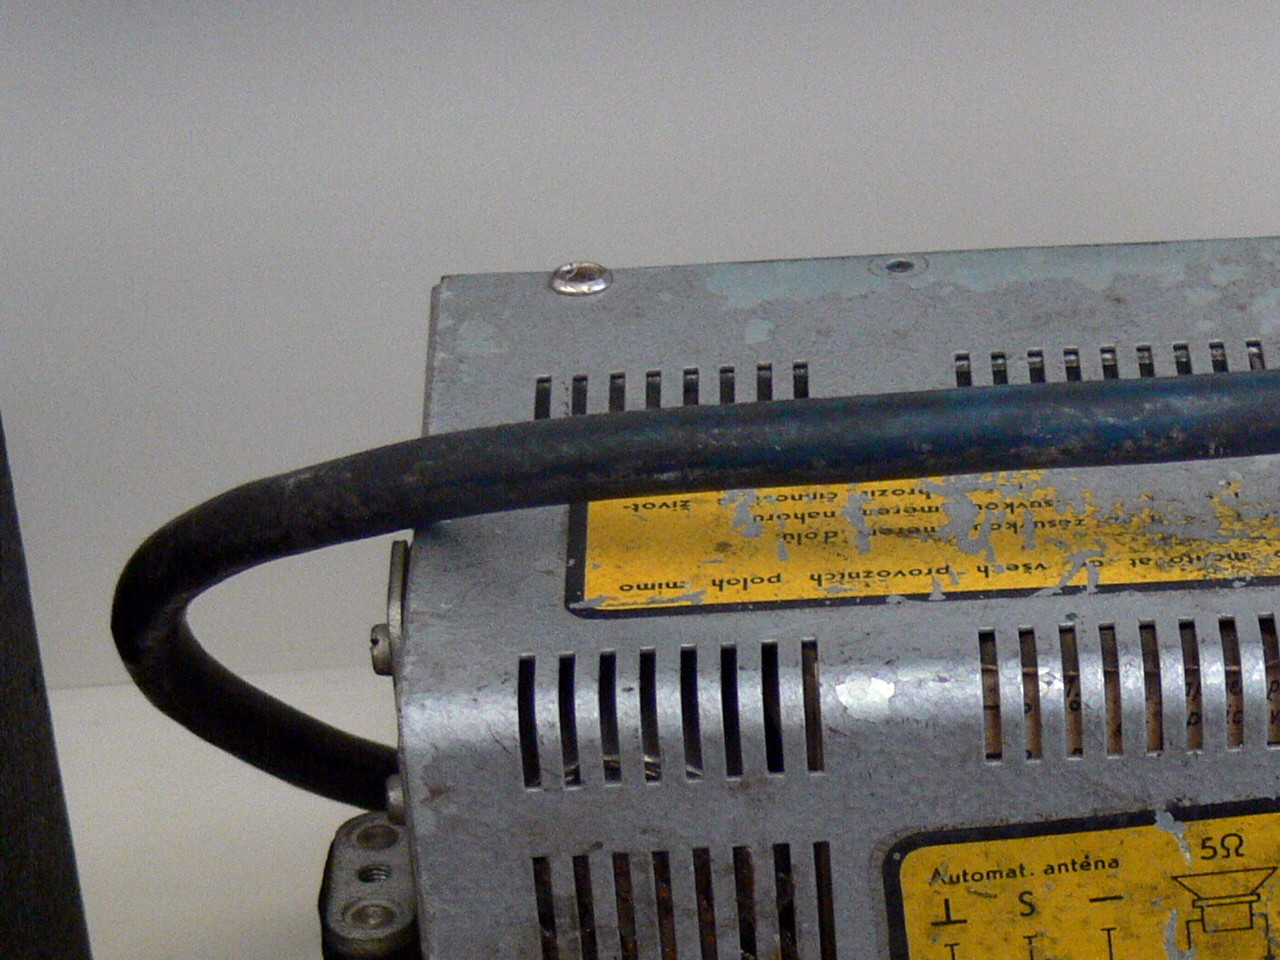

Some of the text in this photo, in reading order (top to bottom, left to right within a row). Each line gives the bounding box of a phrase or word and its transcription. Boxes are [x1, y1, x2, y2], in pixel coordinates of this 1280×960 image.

[622, 499, 691, 513] život-
[753, 511, 836, 525] nahoru
[619, 580, 686, 594] mimo
[711, 573, 781, 592] poloh
[1043, 855, 1120, 875] anténa
